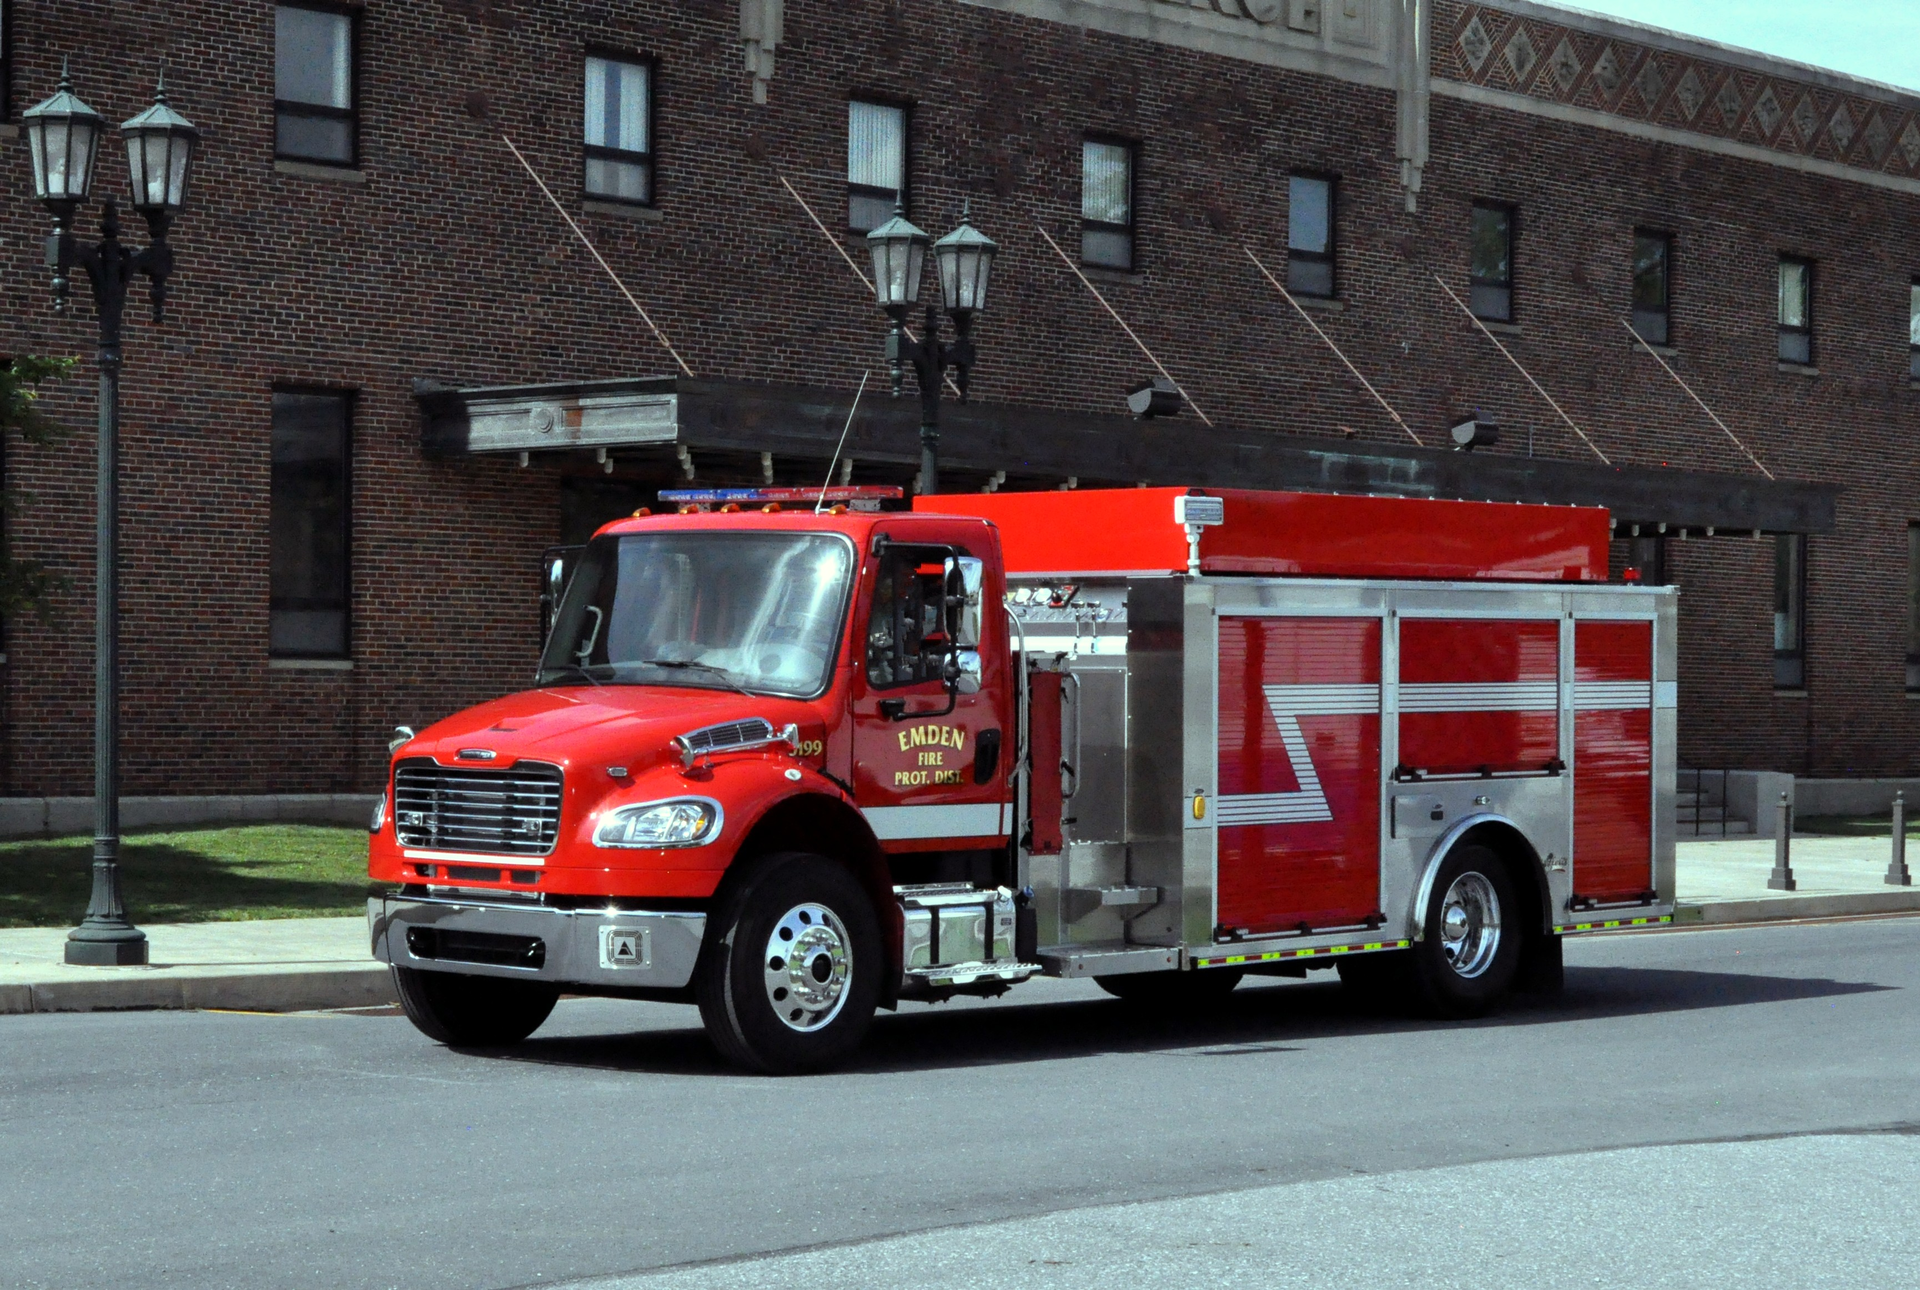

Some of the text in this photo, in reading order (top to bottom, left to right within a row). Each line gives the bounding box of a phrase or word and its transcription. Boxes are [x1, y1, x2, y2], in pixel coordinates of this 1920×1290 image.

[898, 725, 965, 752] EMDEN
[918, 752, 943, 766] FIRE
[894, 770, 964, 786] PROT. DIST.
